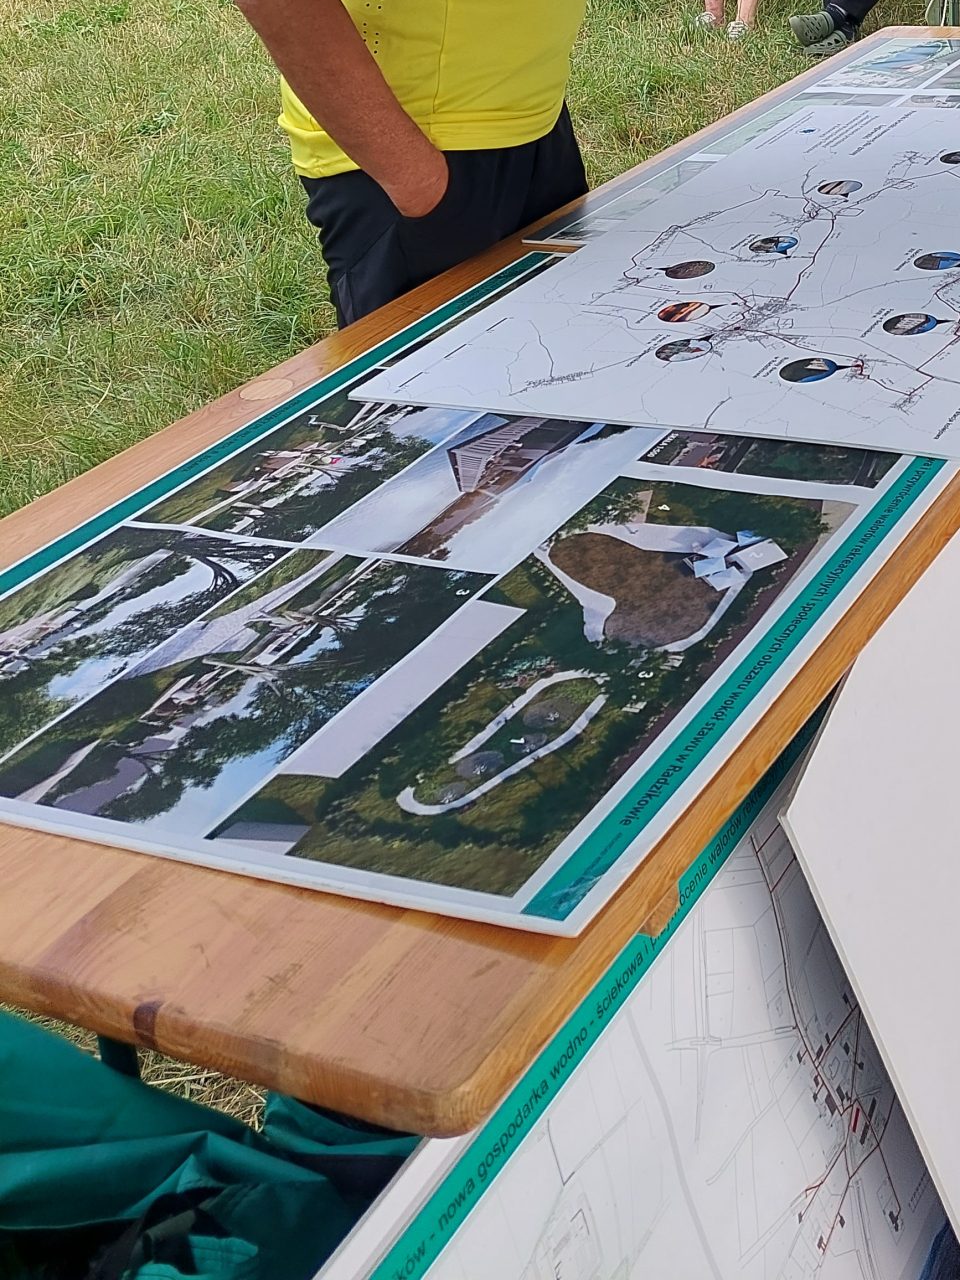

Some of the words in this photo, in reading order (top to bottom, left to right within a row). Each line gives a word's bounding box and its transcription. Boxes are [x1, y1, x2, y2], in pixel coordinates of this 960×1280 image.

[884, 470, 925, 513] przywrócenie
[859, 514, 889, 544] walorów
[814, 545, 863, 596] rekreacyjnych
[768, 602, 815, 652] społecznych
[737, 655, 772, 689] obszaru
[711, 692, 742, 720] wokół
[683, 722, 716, 752] stawu
[675, 754, 689, 763] w
[620, 765, 682, 825] Radzikowie
[438, 1178, 475, 1231] nowa
[477, 1080, 548, 1182] gospodarka
[550, 1029, 587, 1079] wodno
[597, 953, 643, 1019] ściekowa
[650, 862, 708, 952] pócenie
[709, 814, 747, 863] walorów
